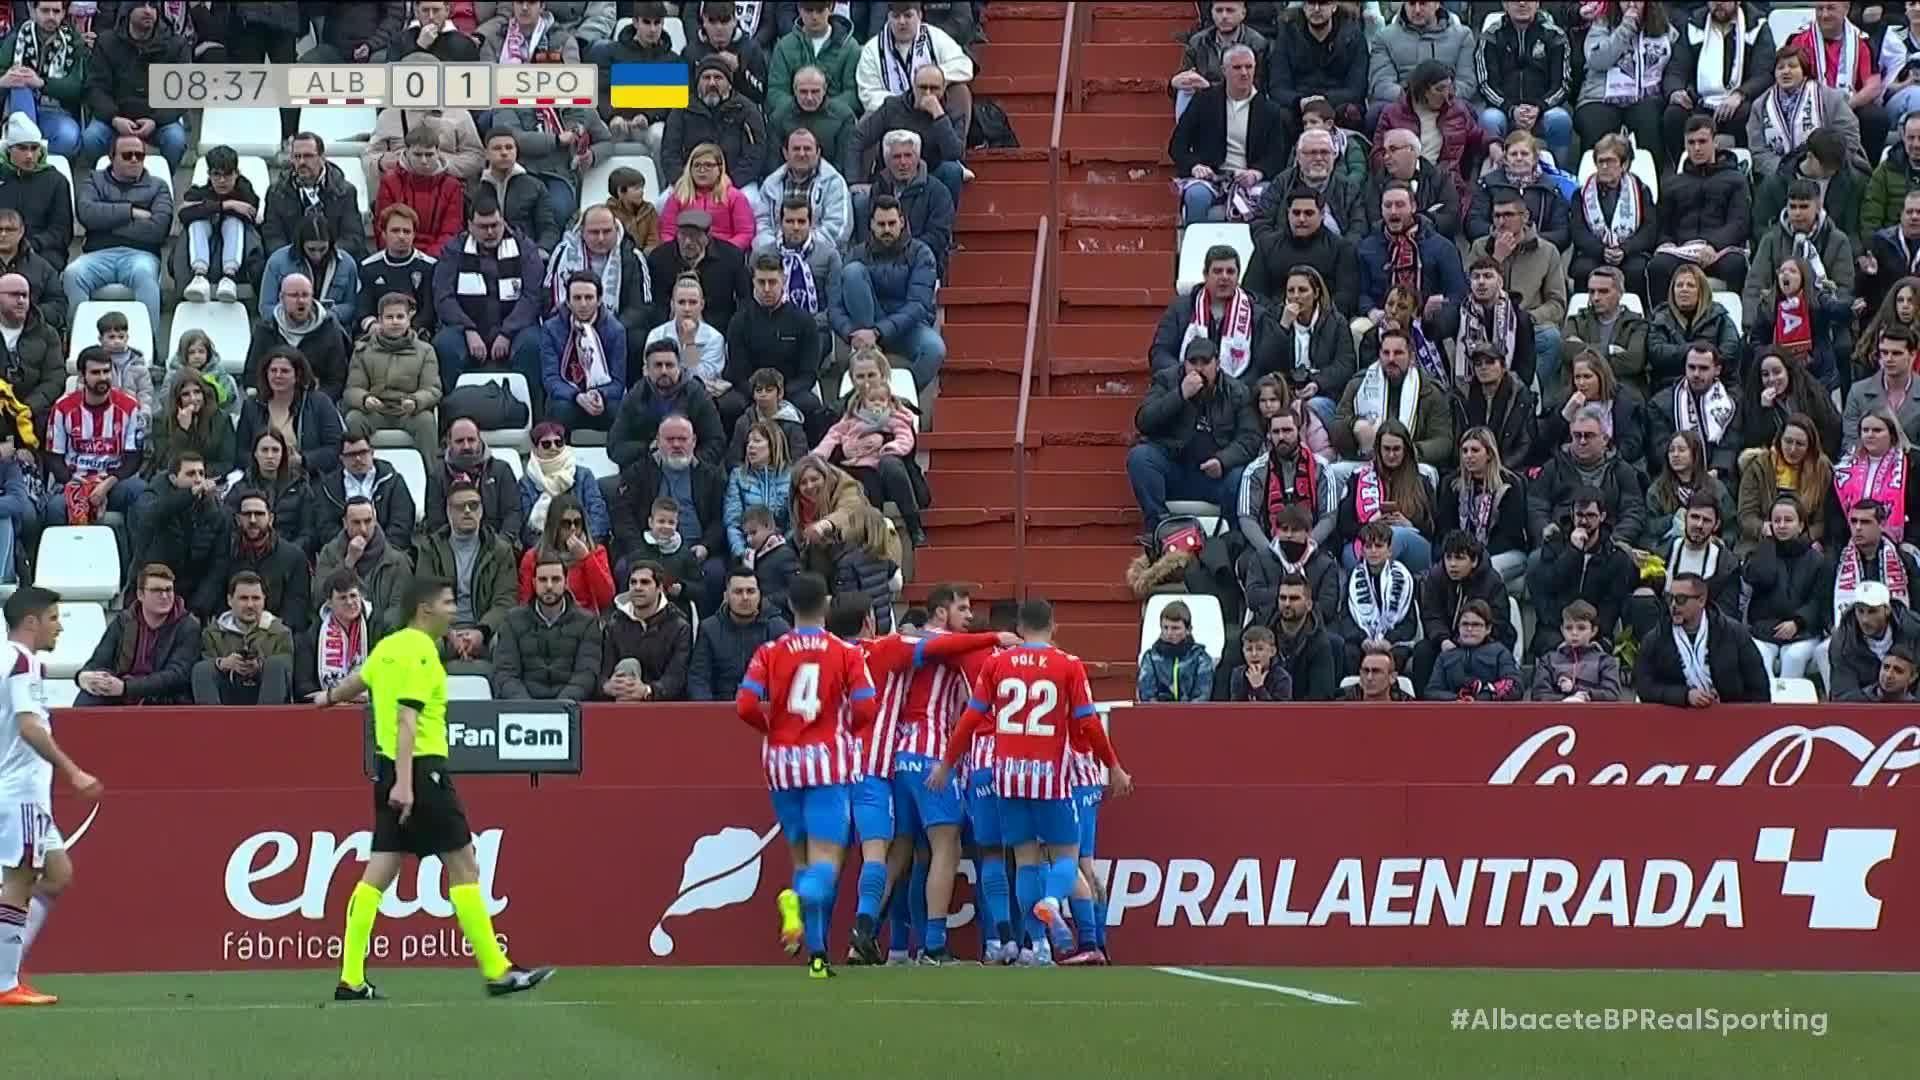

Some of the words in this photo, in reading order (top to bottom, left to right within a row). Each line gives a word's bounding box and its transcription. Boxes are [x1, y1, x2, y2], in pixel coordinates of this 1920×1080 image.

[787, 662, 822, 723] 4
[997, 677, 1058, 737] 22
[504, 723, 563, 747] Cam
[944, 858, 1744, 929] CPRALAENTRADA
[402, 928, 509, 961] pelles
